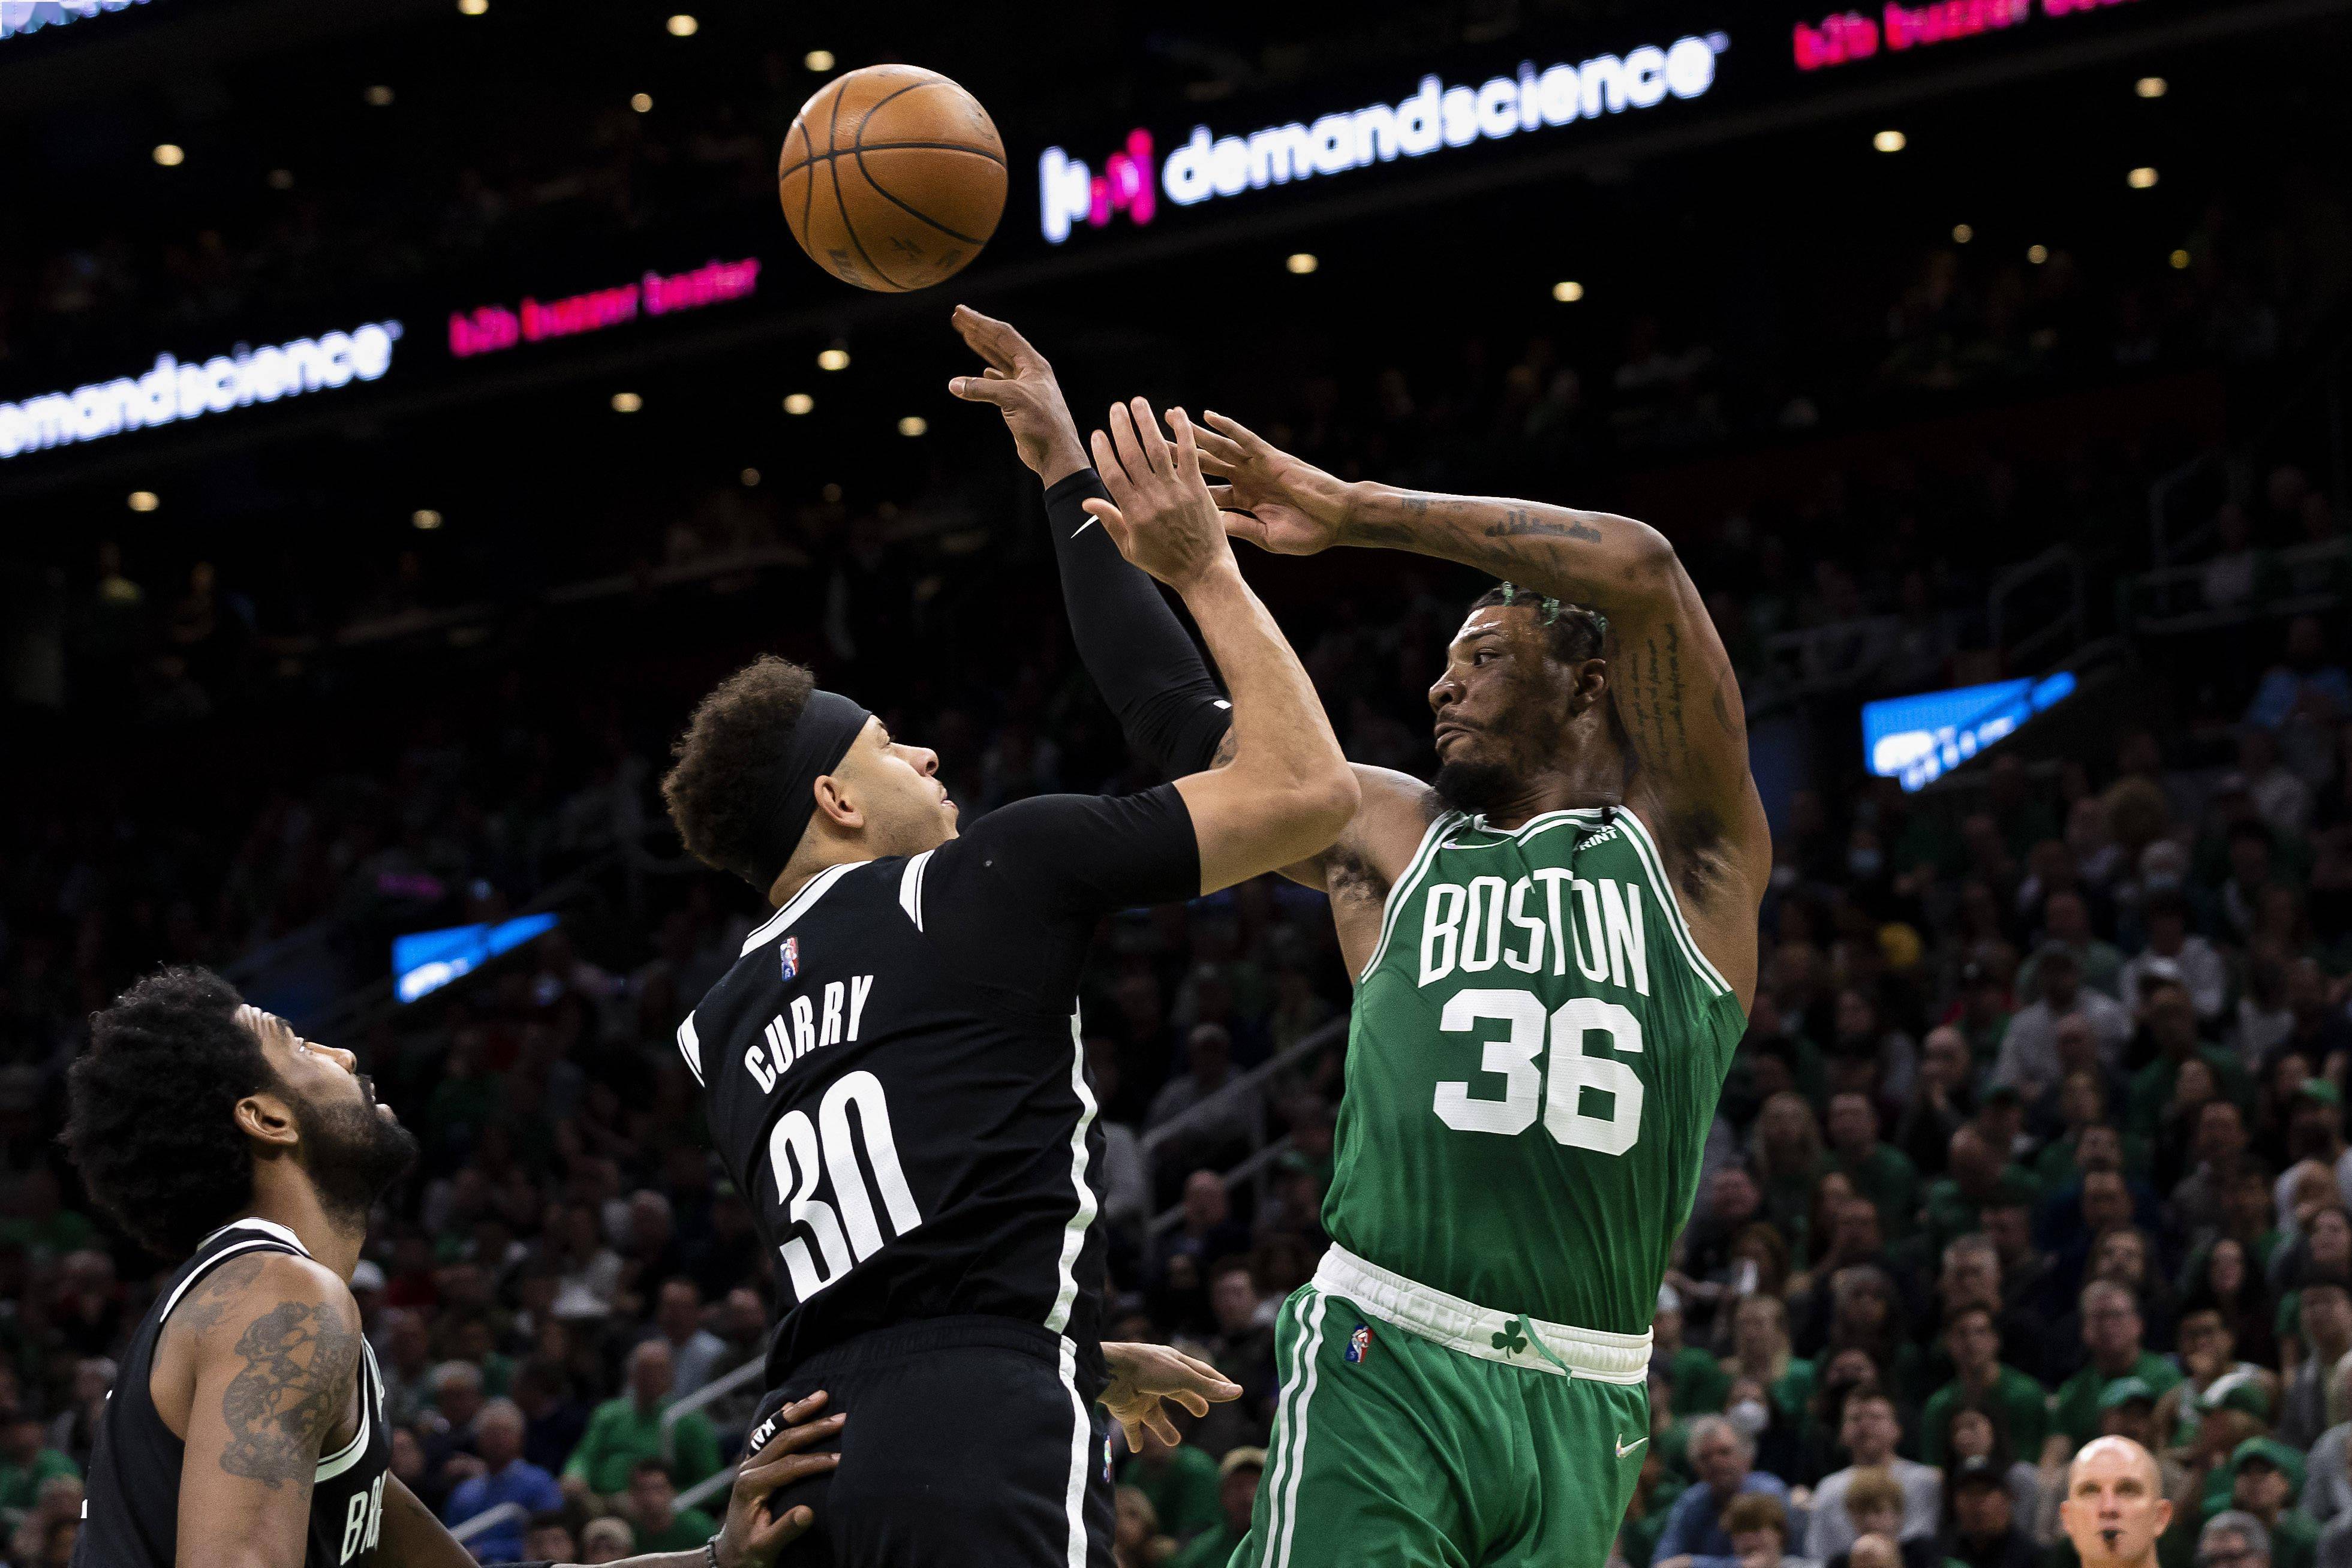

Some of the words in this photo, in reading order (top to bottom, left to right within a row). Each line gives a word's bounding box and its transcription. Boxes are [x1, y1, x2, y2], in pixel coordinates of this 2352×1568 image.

[1162, 34, 1716, 205] demandscience
[1572, 829, 1618, 851] RINT
[1418, 867, 1650, 997] BOSTON
[744, 974, 874, 1094] CURRY
[1433, 988, 1644, 1156] 36
[769, 1070, 922, 1304] 30
